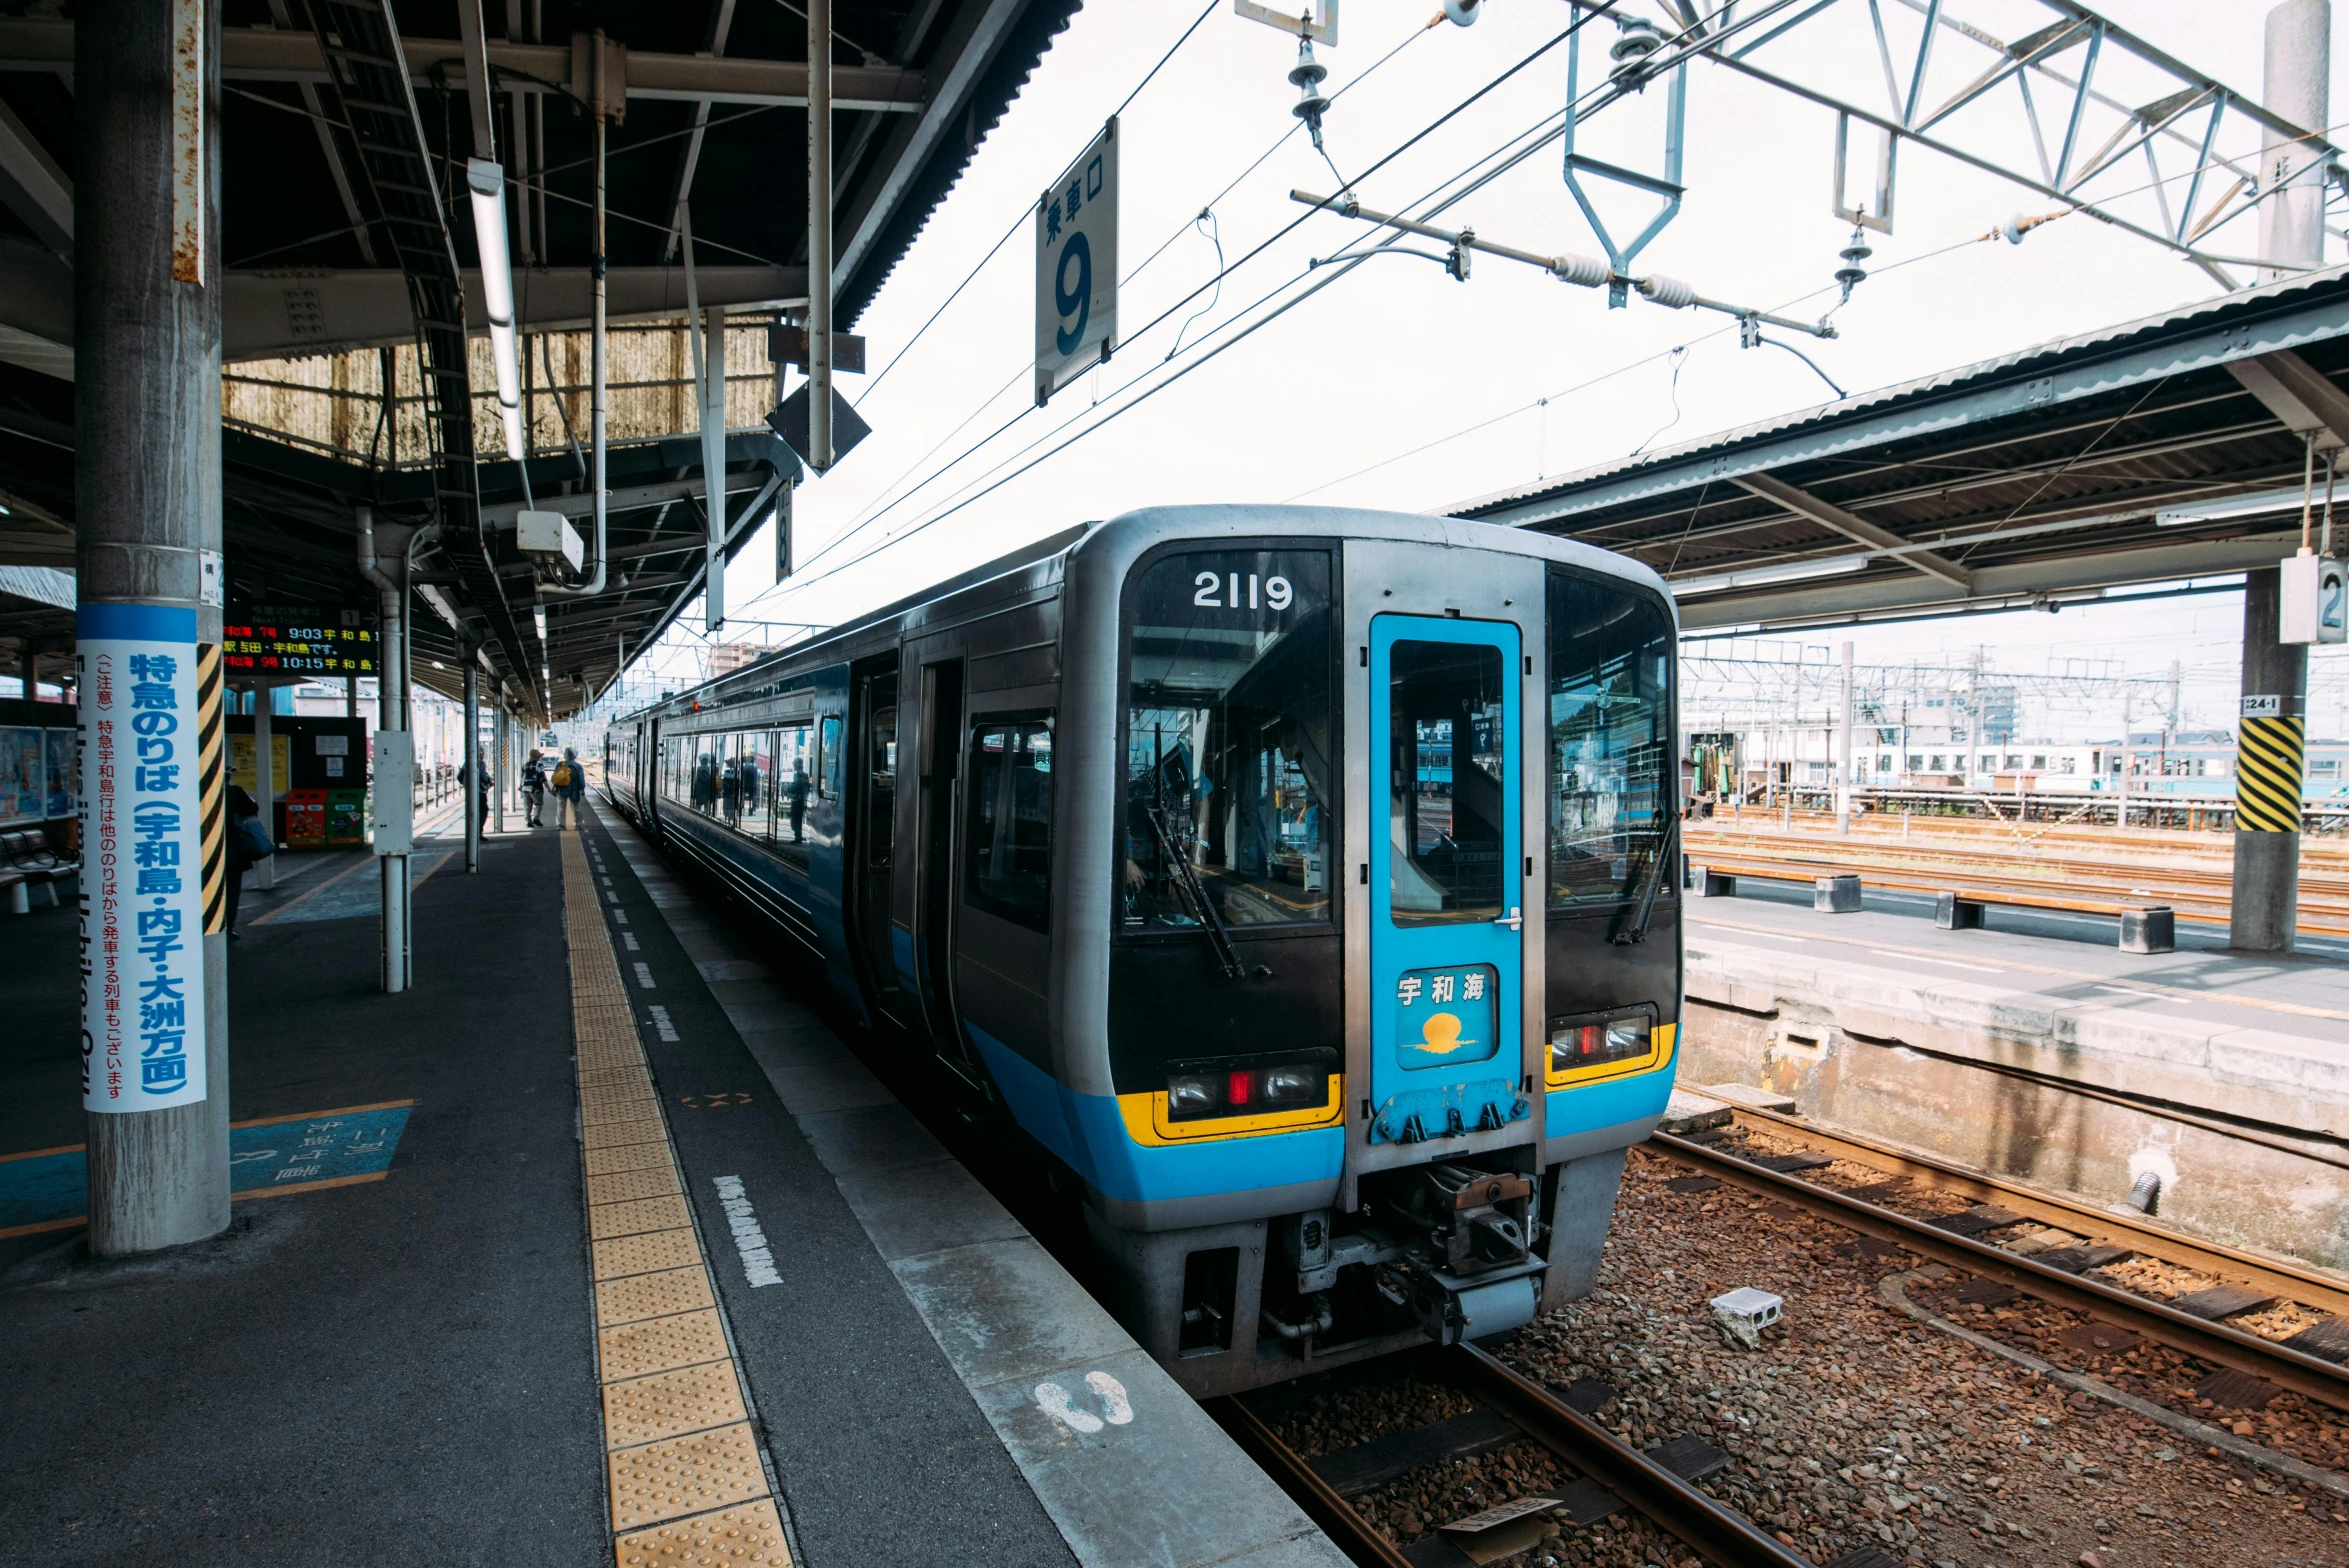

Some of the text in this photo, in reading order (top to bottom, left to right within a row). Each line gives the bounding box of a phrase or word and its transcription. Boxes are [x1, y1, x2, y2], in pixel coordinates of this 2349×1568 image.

[1046, 153, 1103, 247] 乗車口
[1055, 231, 1092, 356] 9
[779, 515, 787, 569] 8
[1194, 571, 1293, 610] 2119
[2322, 572, 2342, 628] 2
[252, 616, 304, 625] Next Train
[289, 628, 322, 640] 9:03
[282, 657, 323, 669] 10:15
[1397, 973, 1485, 1006] 宇和海
